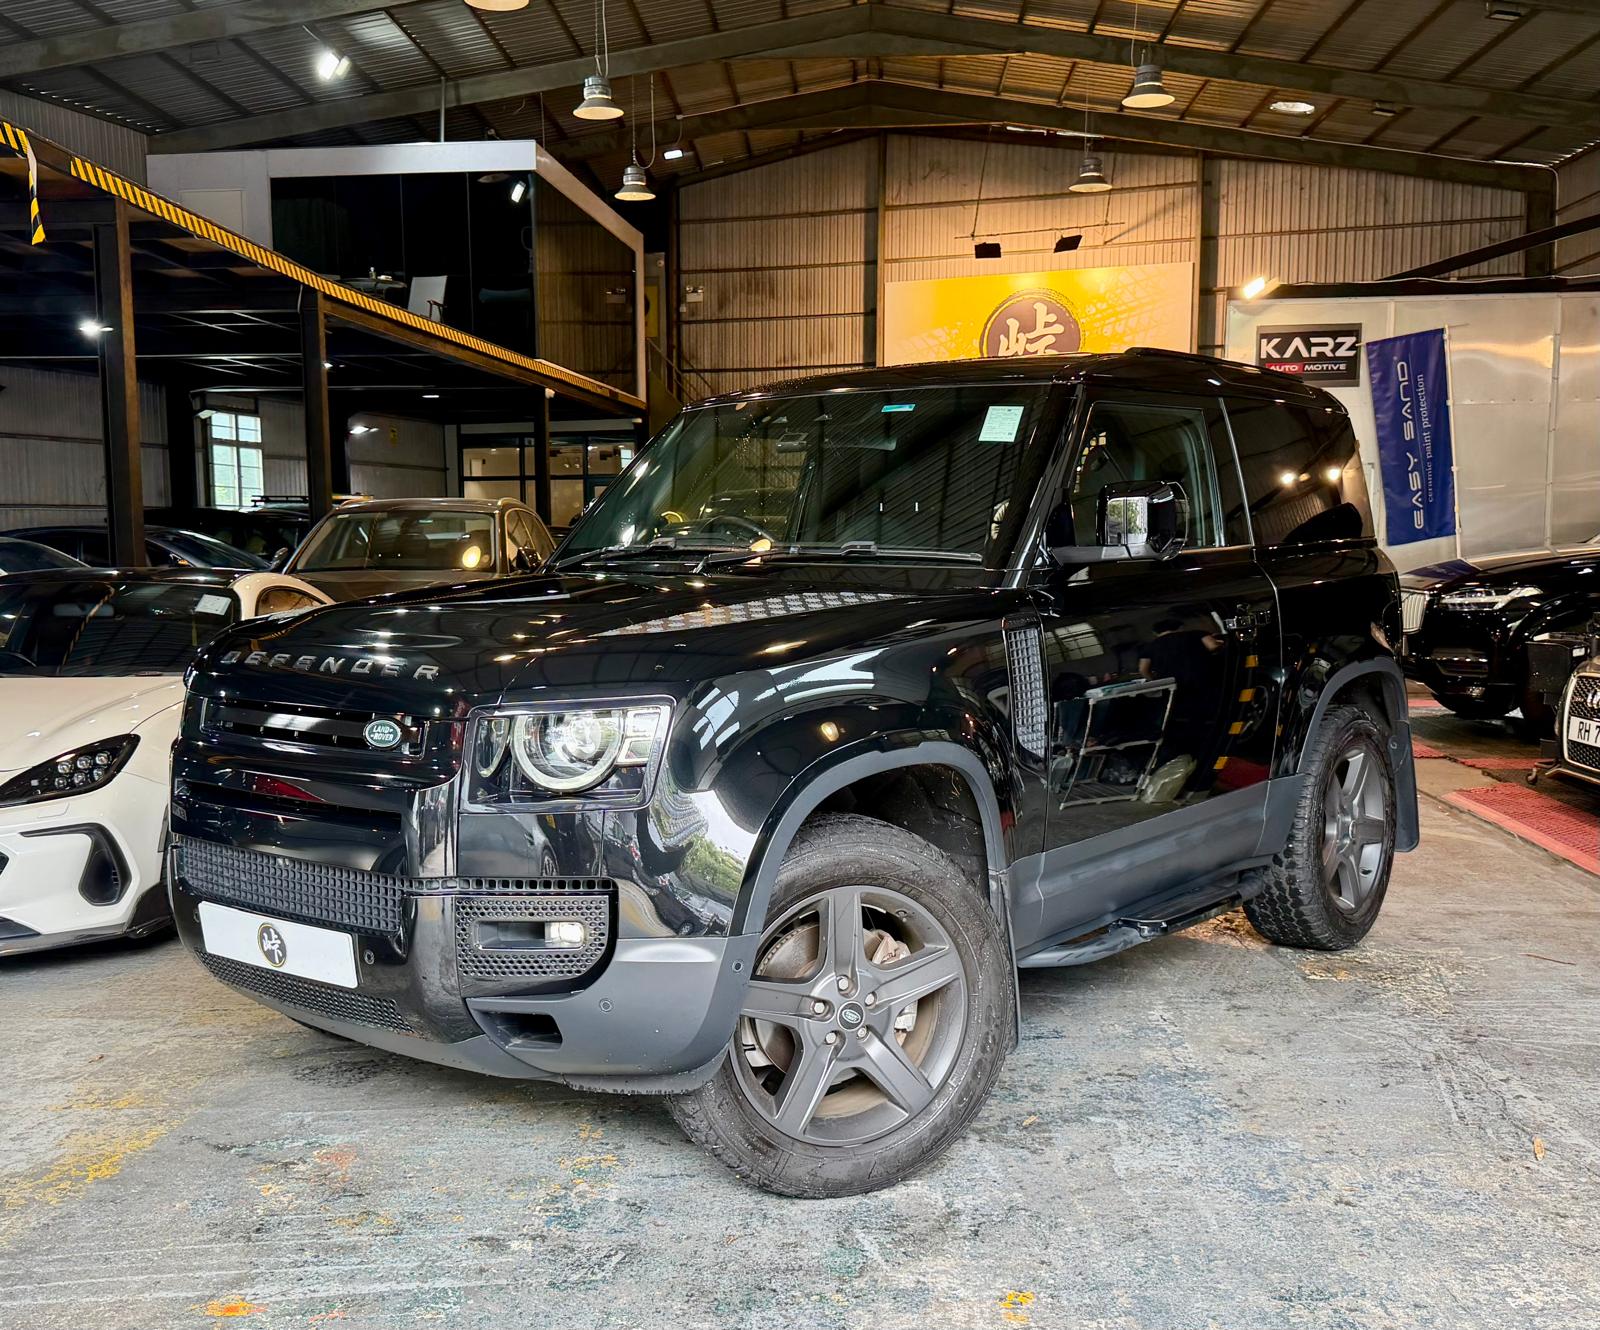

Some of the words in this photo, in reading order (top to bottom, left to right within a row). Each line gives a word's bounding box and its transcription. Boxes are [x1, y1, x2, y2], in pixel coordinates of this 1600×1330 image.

[1260, 336, 1357, 359] KARZ
[1270, 364, 1298, 372] AUTO
[1304, 363, 1347, 371] MOTIVE
[1397, 361, 1415, 441] SAND
[1416, 374, 1432, 429] protection
[1423, 432, 1433, 459] paint
[1406, 451, 1424, 529] EASY
[1425, 461, 1434, 503] ceramic
[220, 650, 440, 681] DEFENDER
[1577, 720, 1591, 742] RH
